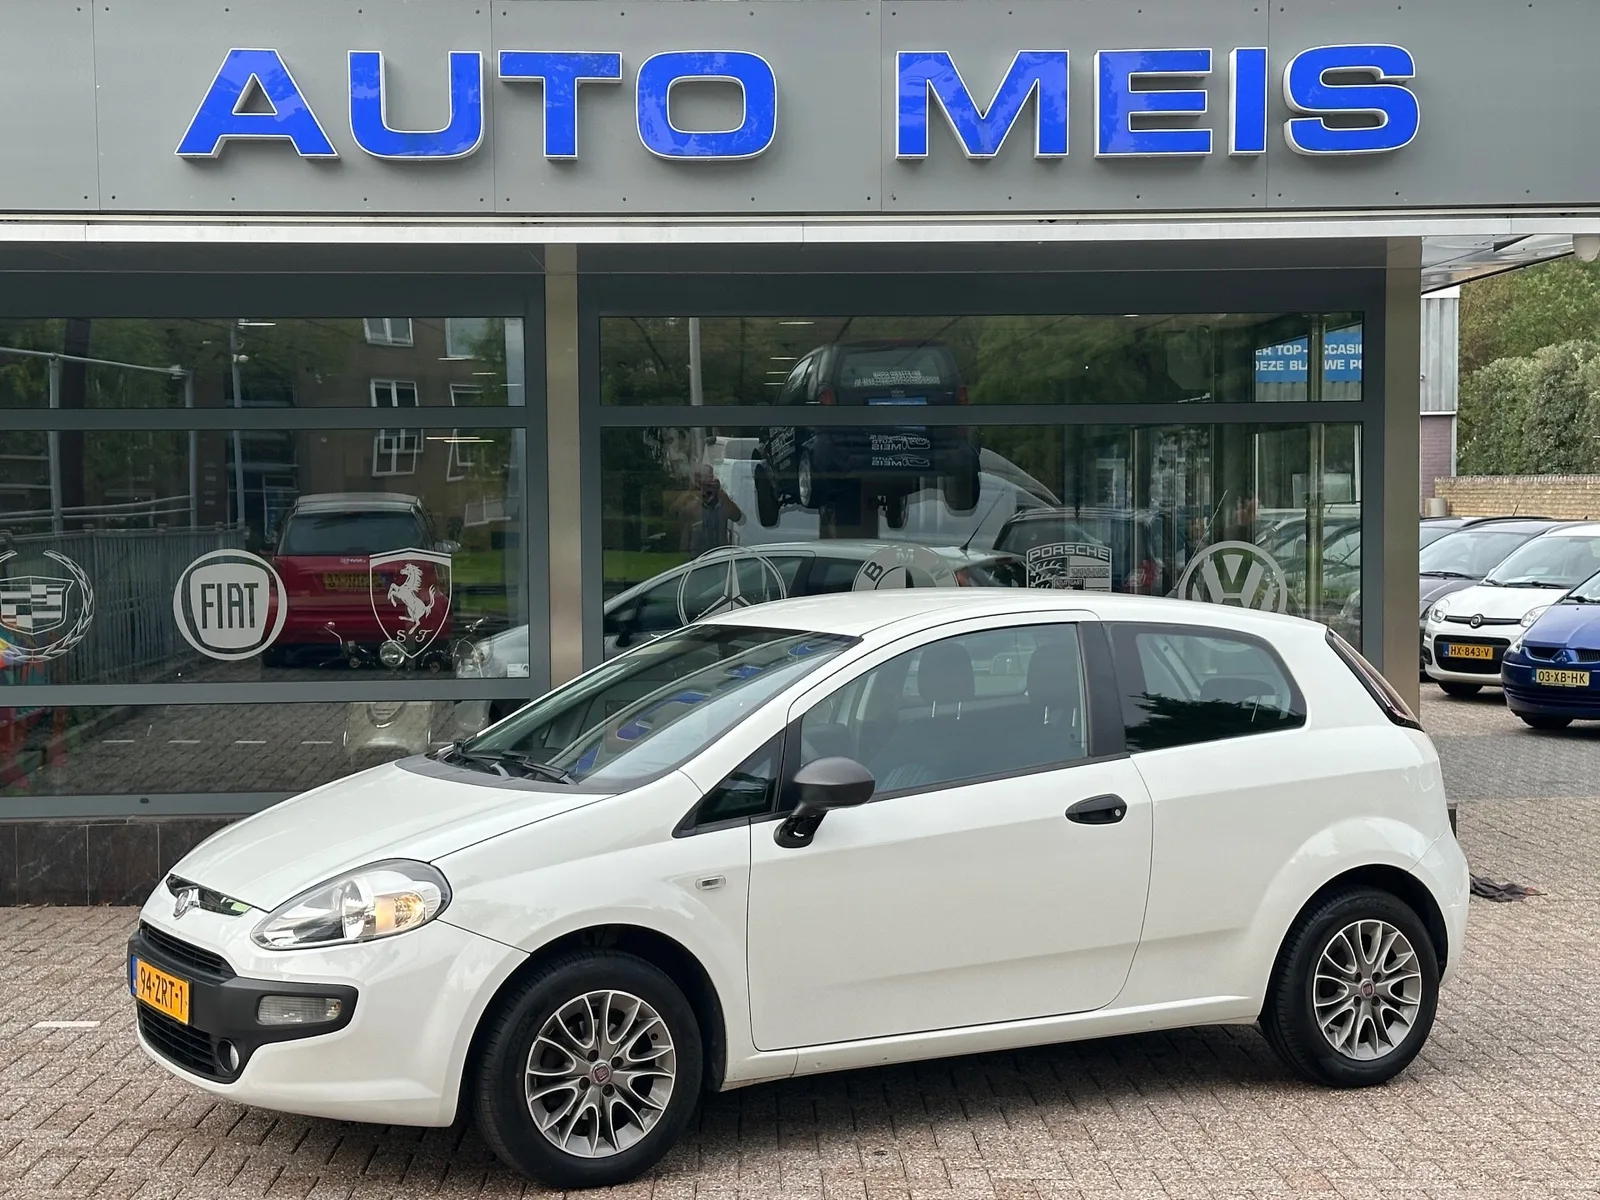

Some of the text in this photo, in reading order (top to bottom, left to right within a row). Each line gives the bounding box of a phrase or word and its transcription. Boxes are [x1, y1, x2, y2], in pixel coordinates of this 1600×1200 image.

[174, 43, 1420, 161] AUTO MEIS
[1349, 359, 1362, 370] P
[1029, 544, 1110, 562] PORSCHE
[200, 582, 259, 629] FIAT
[396, 629, 407, 643] S
[1450, 645, 1491, 658] HX-843-V
[1538, 670, 1586, 684] 03-XB-HK
[140, 966, 183, 1015] 94-ZRT-1
